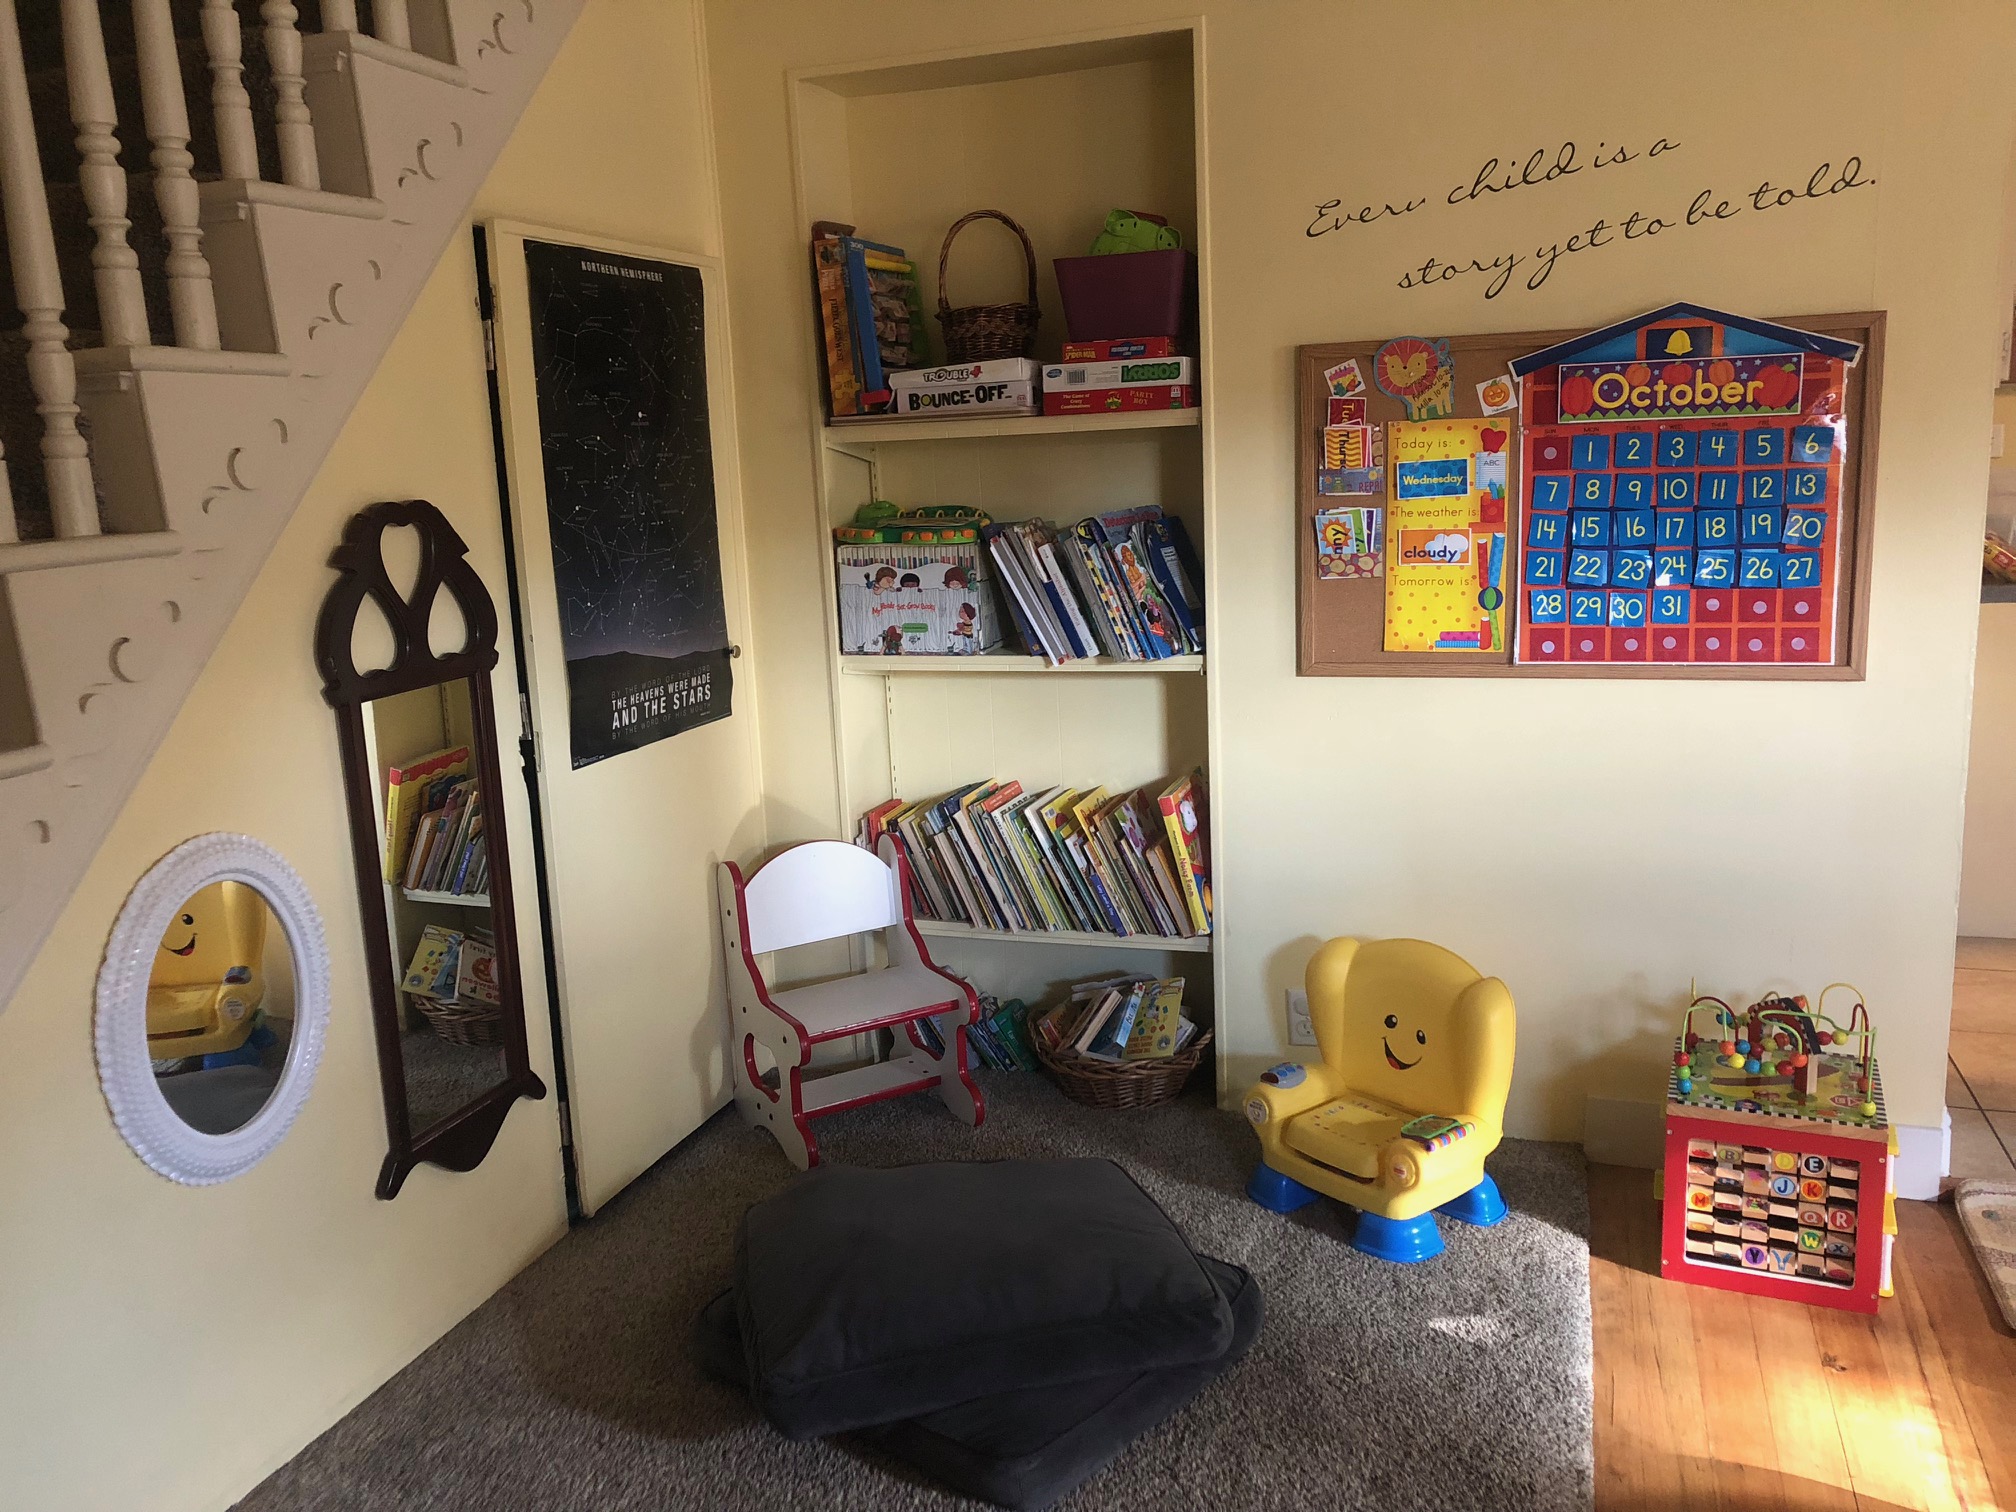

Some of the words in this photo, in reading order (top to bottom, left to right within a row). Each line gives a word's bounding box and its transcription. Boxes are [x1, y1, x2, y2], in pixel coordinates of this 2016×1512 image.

[1447, 142, 1583, 206] child
[1593, 142, 1639, 168] is
[1648, 138, 1681, 156] a
[1397, 254, 1526, 299] story
[1527, 219, 1614, 290] yet
[1621, 211, 1676, 239] to
[1686, 189, 1742, 225] be
[1748, 156, 1877, 211] told.
[850, 241, 864, 250] 300
[581, 261, 619, 276] NORTHERN
[620, 268, 663, 282] HEMISPHERE
[923, 368, 970, 382] TROUBLE
[908, 384, 1008, 411] BOUNCE-OFF
[1130, 390, 1154, 398] PARTY
[1592, 369, 1765, 409] October
[1394, 438, 1433, 455] Today
[1438, 438, 1452, 448] is:
[1587, 440, 1594, 462] 1
[1628, 438, 1641, 460] 2
[1670, 437, 1685, 459] 3
[1710, 435, 1726, 458] 4
[1756, 434, 1772, 458] 5
[1804, 432, 1820, 456] 6
[1403, 475, 1464, 487] Wednesday
[1546, 481, 1559, 503] 7
[1584, 479, 1600, 500] 8
[1628, 480, 1642, 502] 9
[1663, 478, 1688, 500] 10
[1712, 478, 1726, 500] 11
[1752, 476, 1774, 499] 12
[1794, 473, 1817, 496] 13
[1394, 506, 1414, 517] The
[1417, 506, 1463, 517] weather
[1467, 506, 1480, 516] is:
[1536, 518, 1557, 541] 14
[1580, 516, 1601, 538] 15
[1625, 517, 1646, 538] 16
[1665, 517, 1685, 538] 17
[1704, 517, 1726, 538] 18
[1751, 514, 1772, 536] 19
[1787, 515, 1822, 539] 20
[1404, 546, 1458, 563] cloudy
[1534, 557, 1556, 578] 21
[1572, 555, 1599, 577] 22
[1617, 559, 1645, 580] 23
[1659, 556, 1687, 577] 24
[1701, 558, 1727, 579] 25
[1746, 558, 1774, 578] 26
[1786, 559, 1813, 580] 27
[1392, 575, 1454, 586] Tomorrow
[1459, 574, 1473, 586] is:
[872, 607, 881, 617] My
[921, 603, 936, 612] Books
[1535, 594, 1562, 616] 28
[1575, 597, 1602, 618] 29
[1612, 598, 1643, 619] 30
[1661, 595, 1682, 616] 31
[611, 690, 621, 699] BY
[642, 678, 662, 689] WORD
[665, 675, 674, 683] OF
[679, 671, 690, 679] THE
[694, 665, 711, 675] LORD
[612, 698, 627, 711] THE
[630, 686, 664, 704] HEAVENS
[668, 679, 688, 694] WERE
[691, 673, 711, 687] MADE
[612, 706, 638, 730] AND
[644, 696, 666, 719] THE
[673, 684, 711, 710] STARS
[612, 731, 621, 740] BY
[625, 726, 637, 735] THE
[641, 718, 659, 730] WORD
[663, 715, 672, 723] OF
[675, 710, 687, 719] HIS
[690, 703, 711, 714] MOUTH
[1176, 856, 1193, 879] Noisy
[1184, 878, 1198, 898] Farm
[1726, 1150, 1734, 1160] B
[1809, 1158, 1819, 1171] E
[1778, 1180, 1788, 1193] J
[1806, 1183, 1817, 1197] K
[1695, 1196, 1705, 1205] M
[1804, 1212, 1818, 1223] Q
[1836, 1213, 1848, 1227] R
[1804, 1234, 1819, 1247] W
[1833, 1244, 1844, 1253] X
[1750, 1247, 1759, 1263] Y
